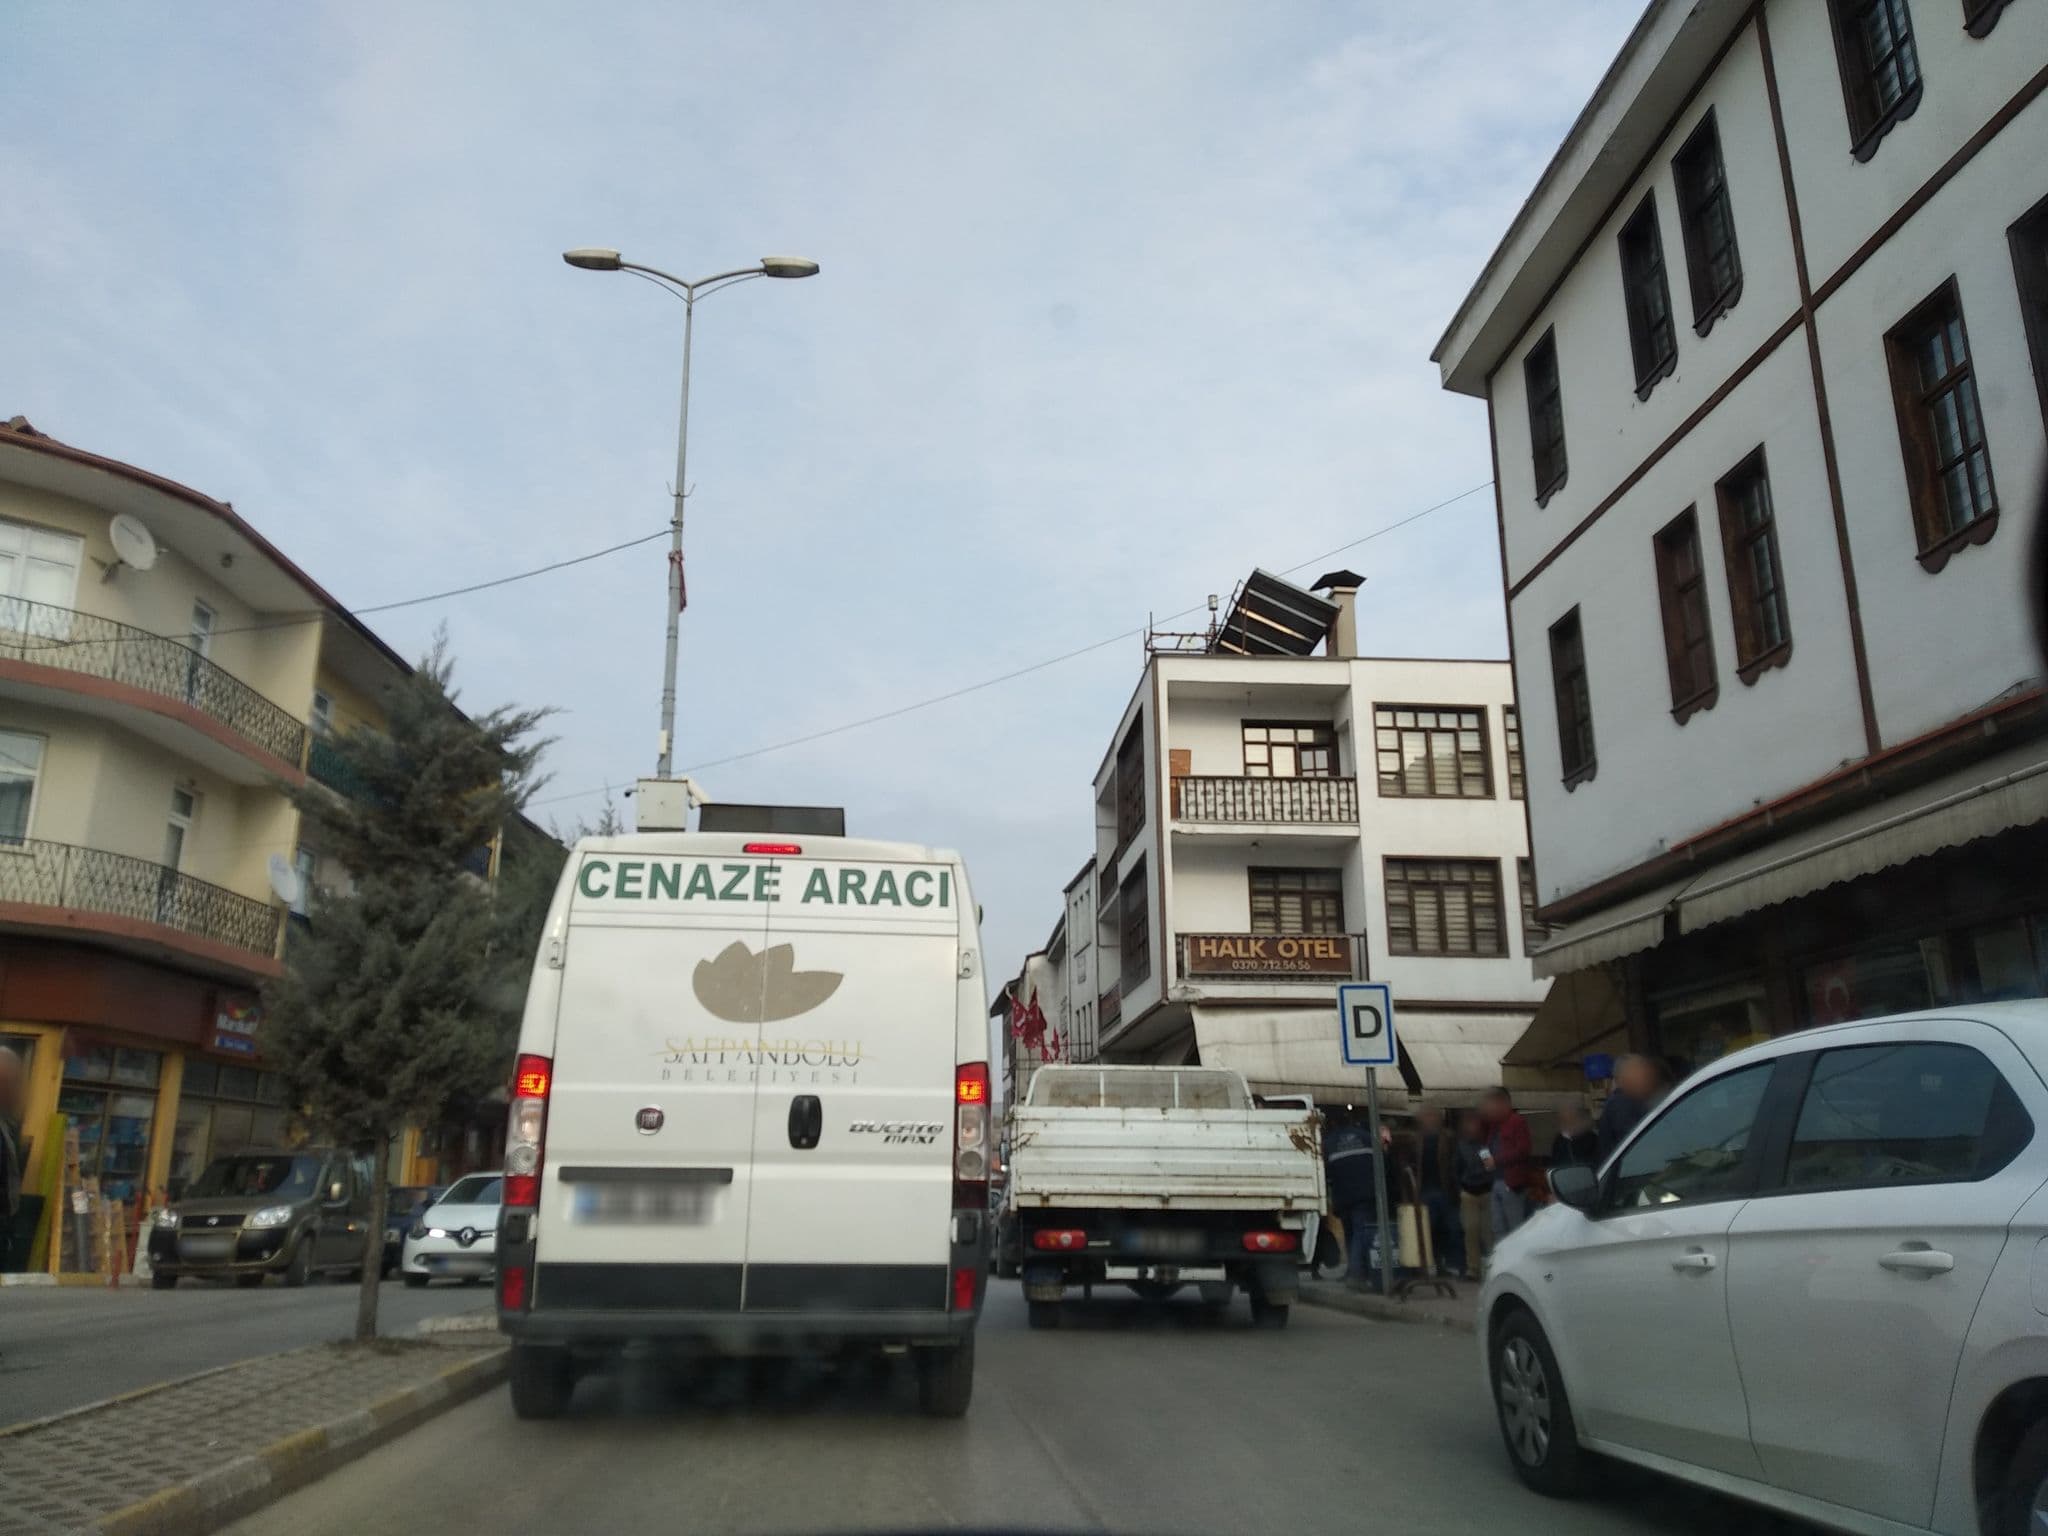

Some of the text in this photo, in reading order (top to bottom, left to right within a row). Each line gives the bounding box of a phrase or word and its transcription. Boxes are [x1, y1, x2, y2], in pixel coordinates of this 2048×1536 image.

[579, 860, 950, 908] CENAZE ARACI
[1200, 938, 1342, 959] HALK OTEL
[1232, 960, 1258, 970] 0370
[1352, 1005, 1382, 1039] D
